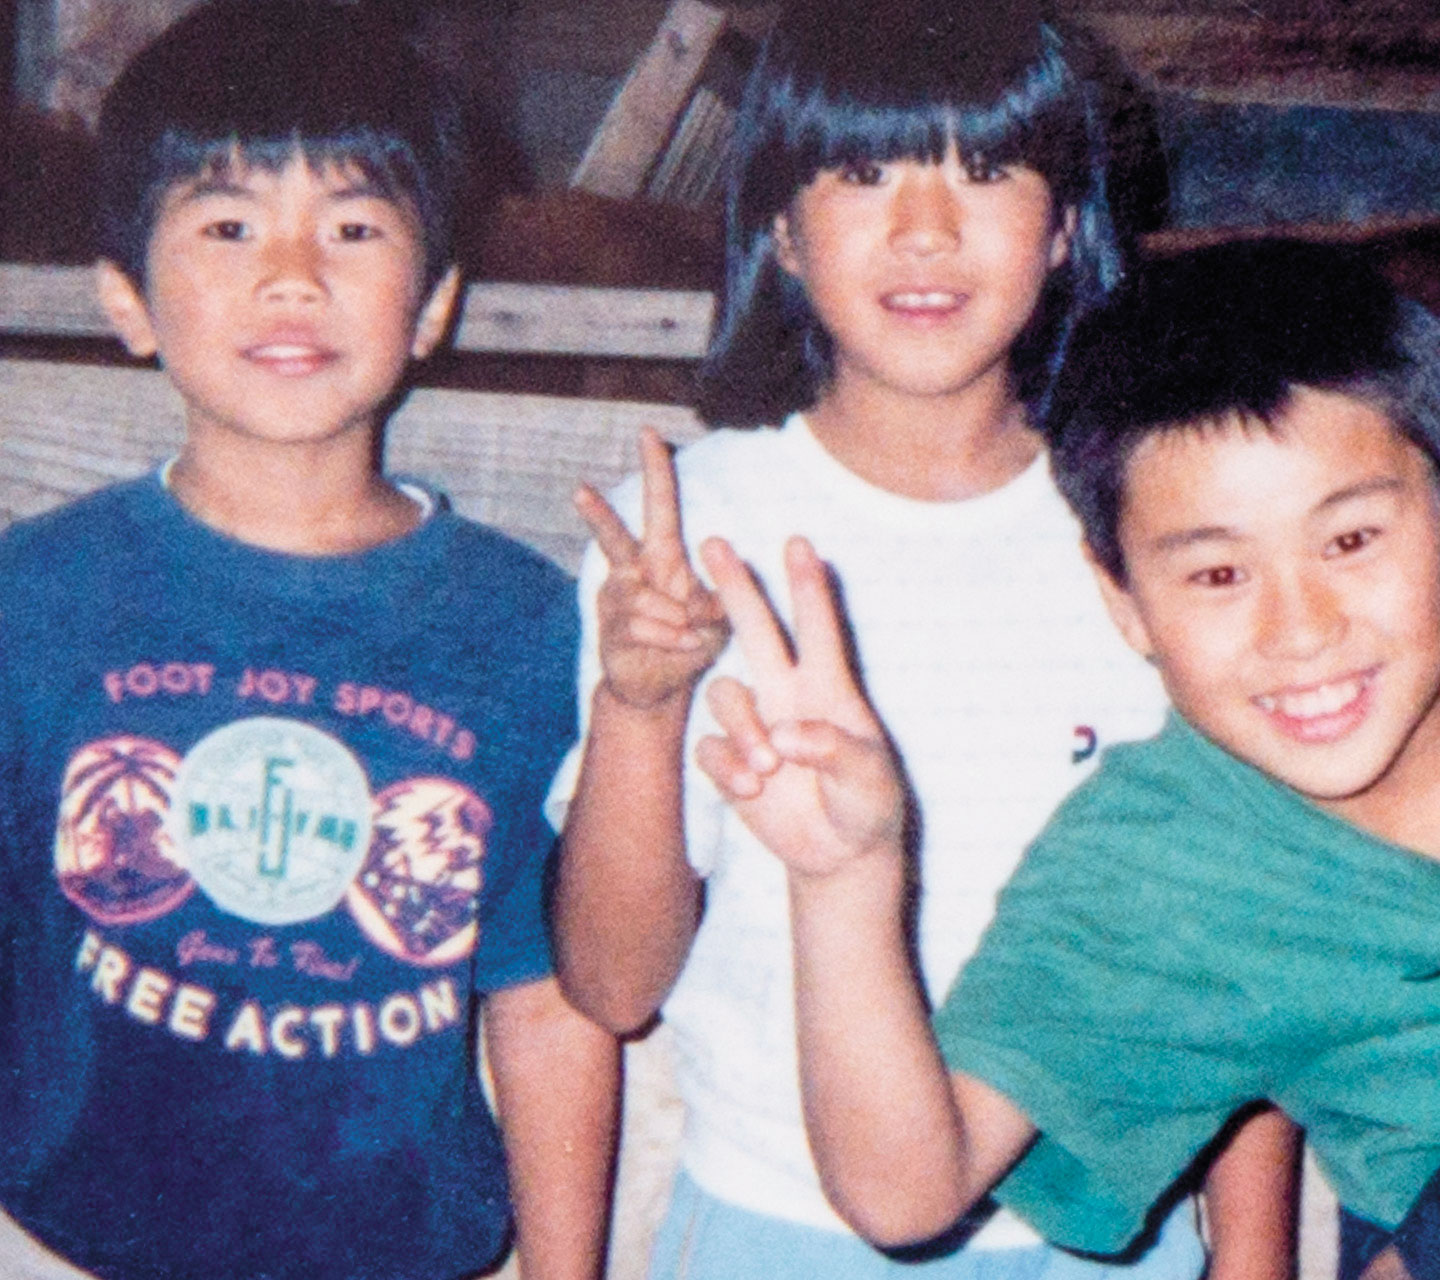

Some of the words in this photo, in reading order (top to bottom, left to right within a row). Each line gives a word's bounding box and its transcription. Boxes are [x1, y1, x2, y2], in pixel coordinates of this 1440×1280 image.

[104, 662, 215, 703] FOOT
[238, 667, 317, 705] JOY
[334, 682, 475, 761] SPORTS
[225, 979, 461, 1059] ACTION
